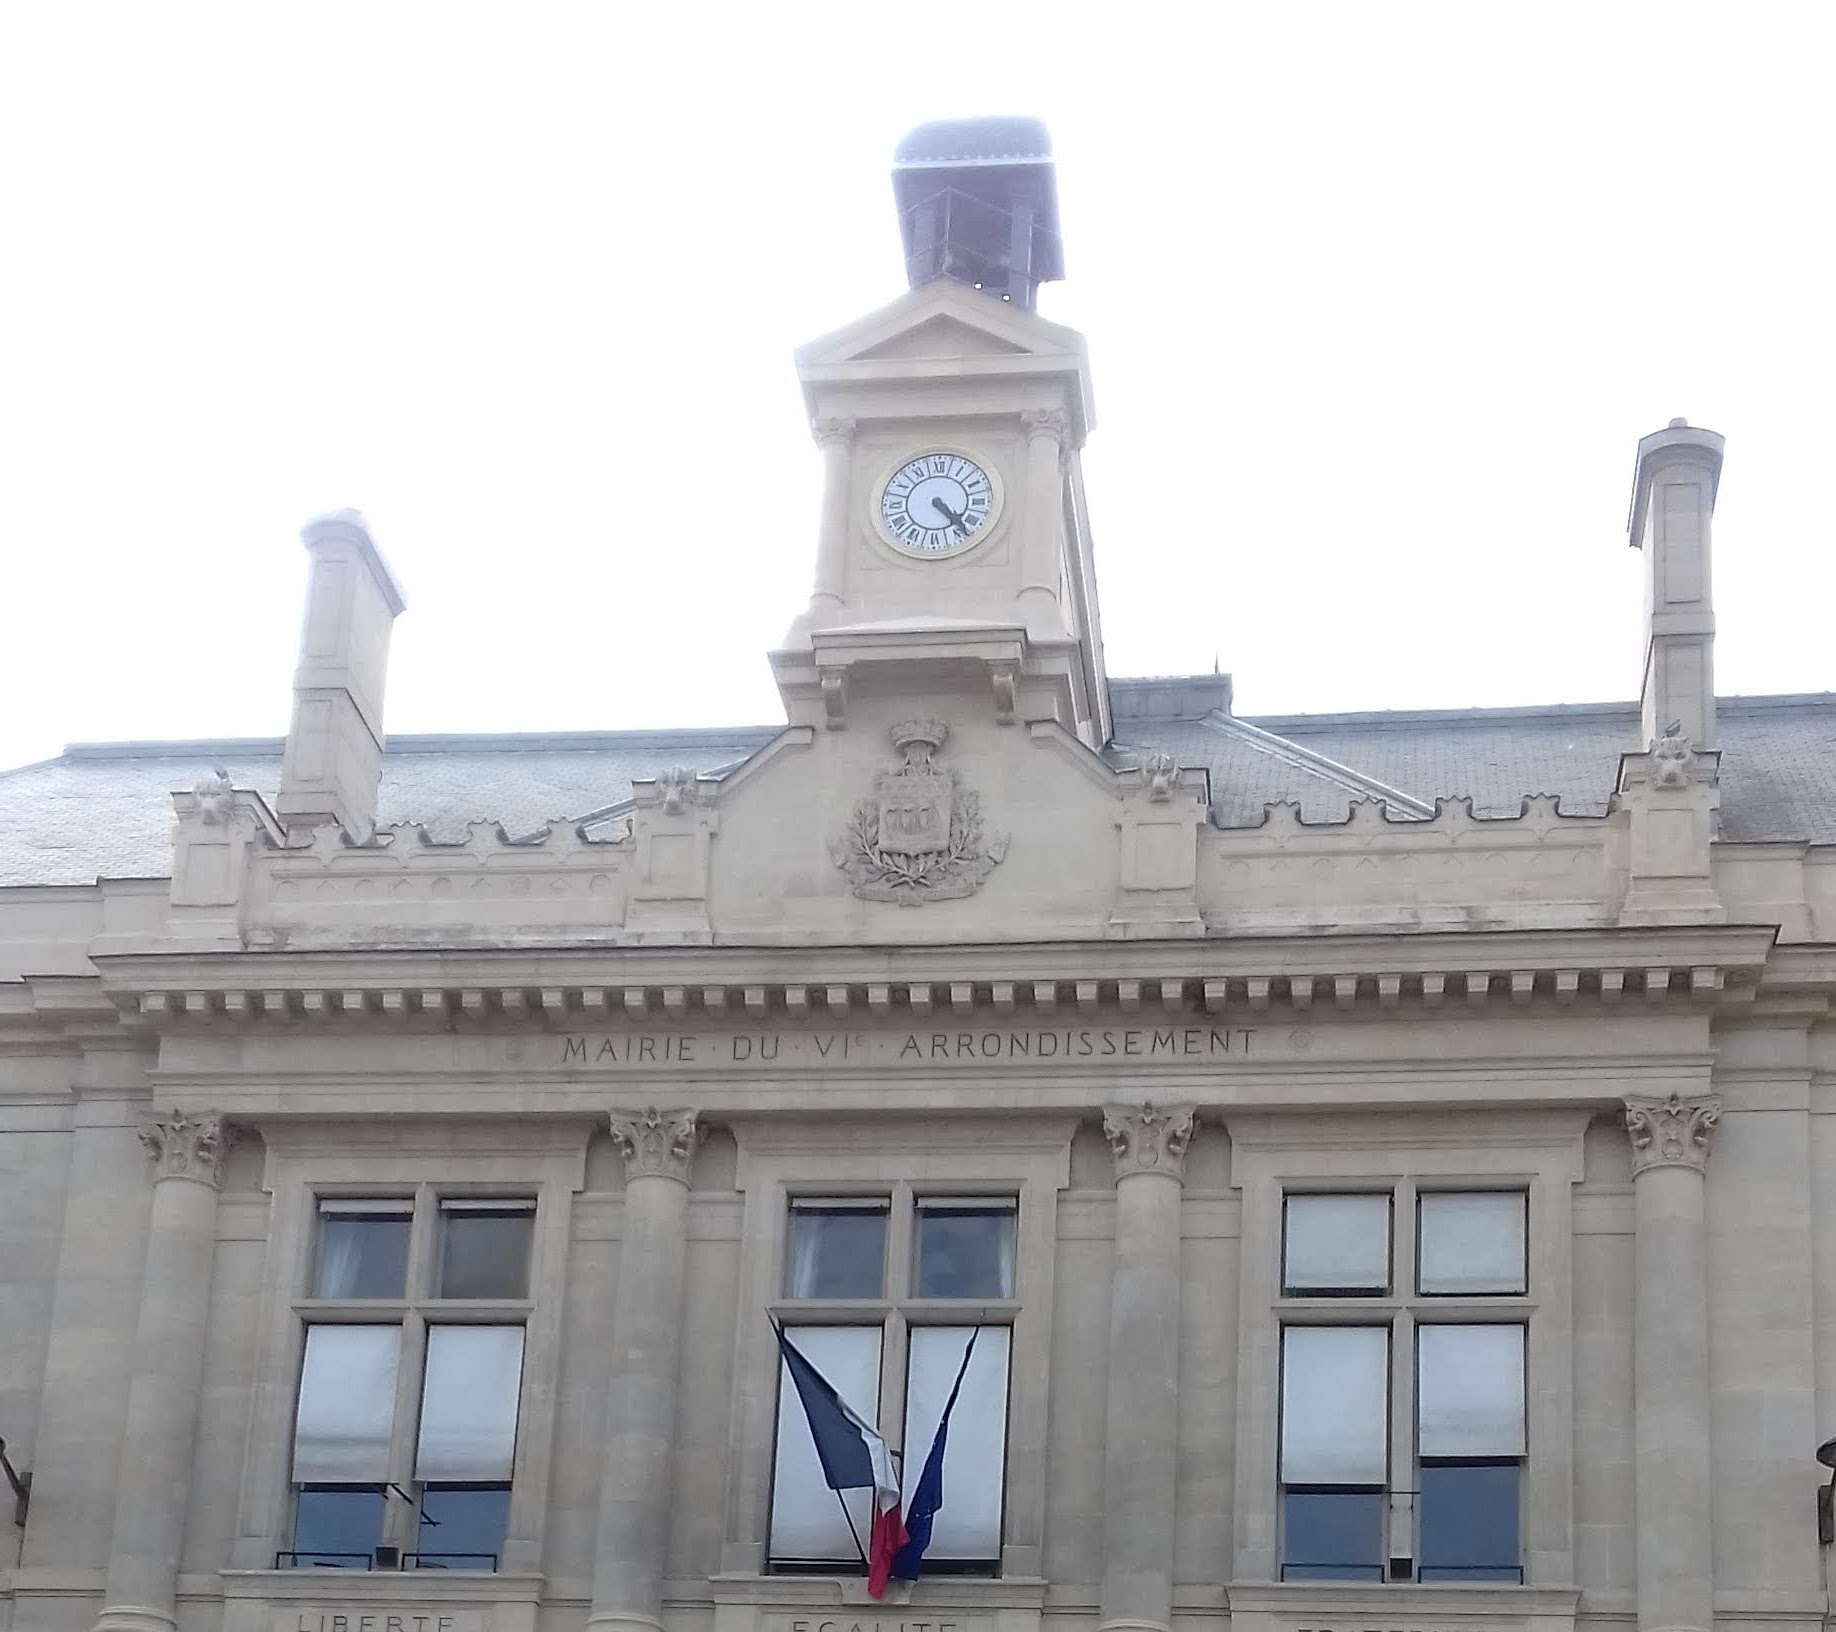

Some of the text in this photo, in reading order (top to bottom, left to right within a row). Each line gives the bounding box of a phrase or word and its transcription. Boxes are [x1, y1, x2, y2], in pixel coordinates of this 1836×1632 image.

[563, 1036, 697, 1063] MAIRIE
[733, 1035, 779, 1061] DU
[900, 1029, 1258, 1058] ARRONDISSEMENT
